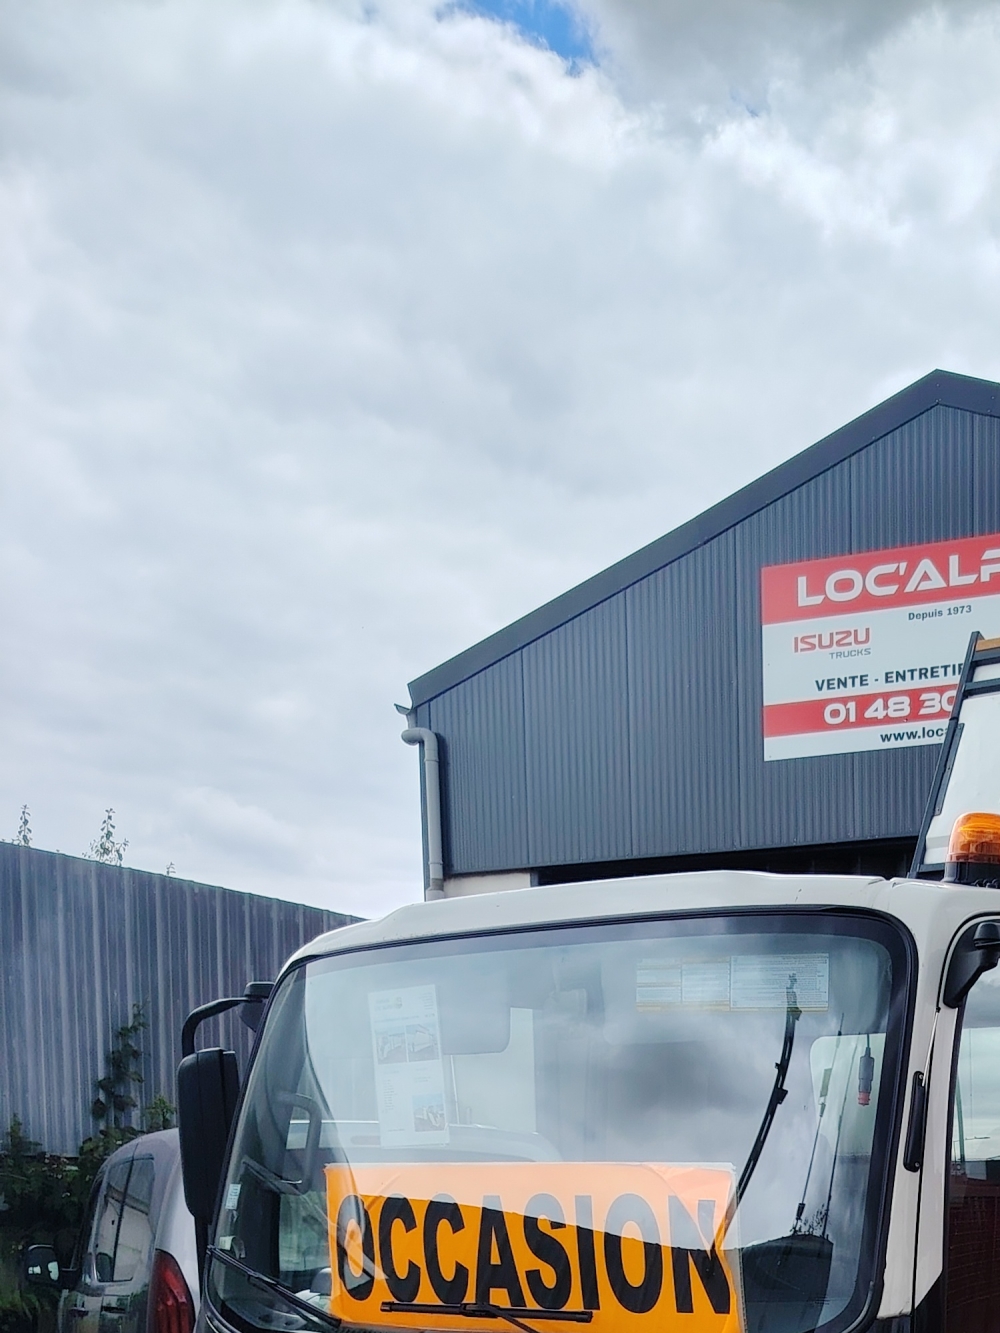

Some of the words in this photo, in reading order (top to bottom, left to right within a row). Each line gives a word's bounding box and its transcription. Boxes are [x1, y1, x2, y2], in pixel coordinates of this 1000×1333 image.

[908, 608, 943, 622] Depuis
[947, 605, 972, 617] 1973
[793, 627, 871, 653] ISUZU
[829, 648, 872, 660] TRUCKS
[815, 674, 870, 692] VENTE
[823, 701, 856, 725] 01
[863, 696, 911, 720] 48
[337, 1192, 731, 1315] OCCASION
